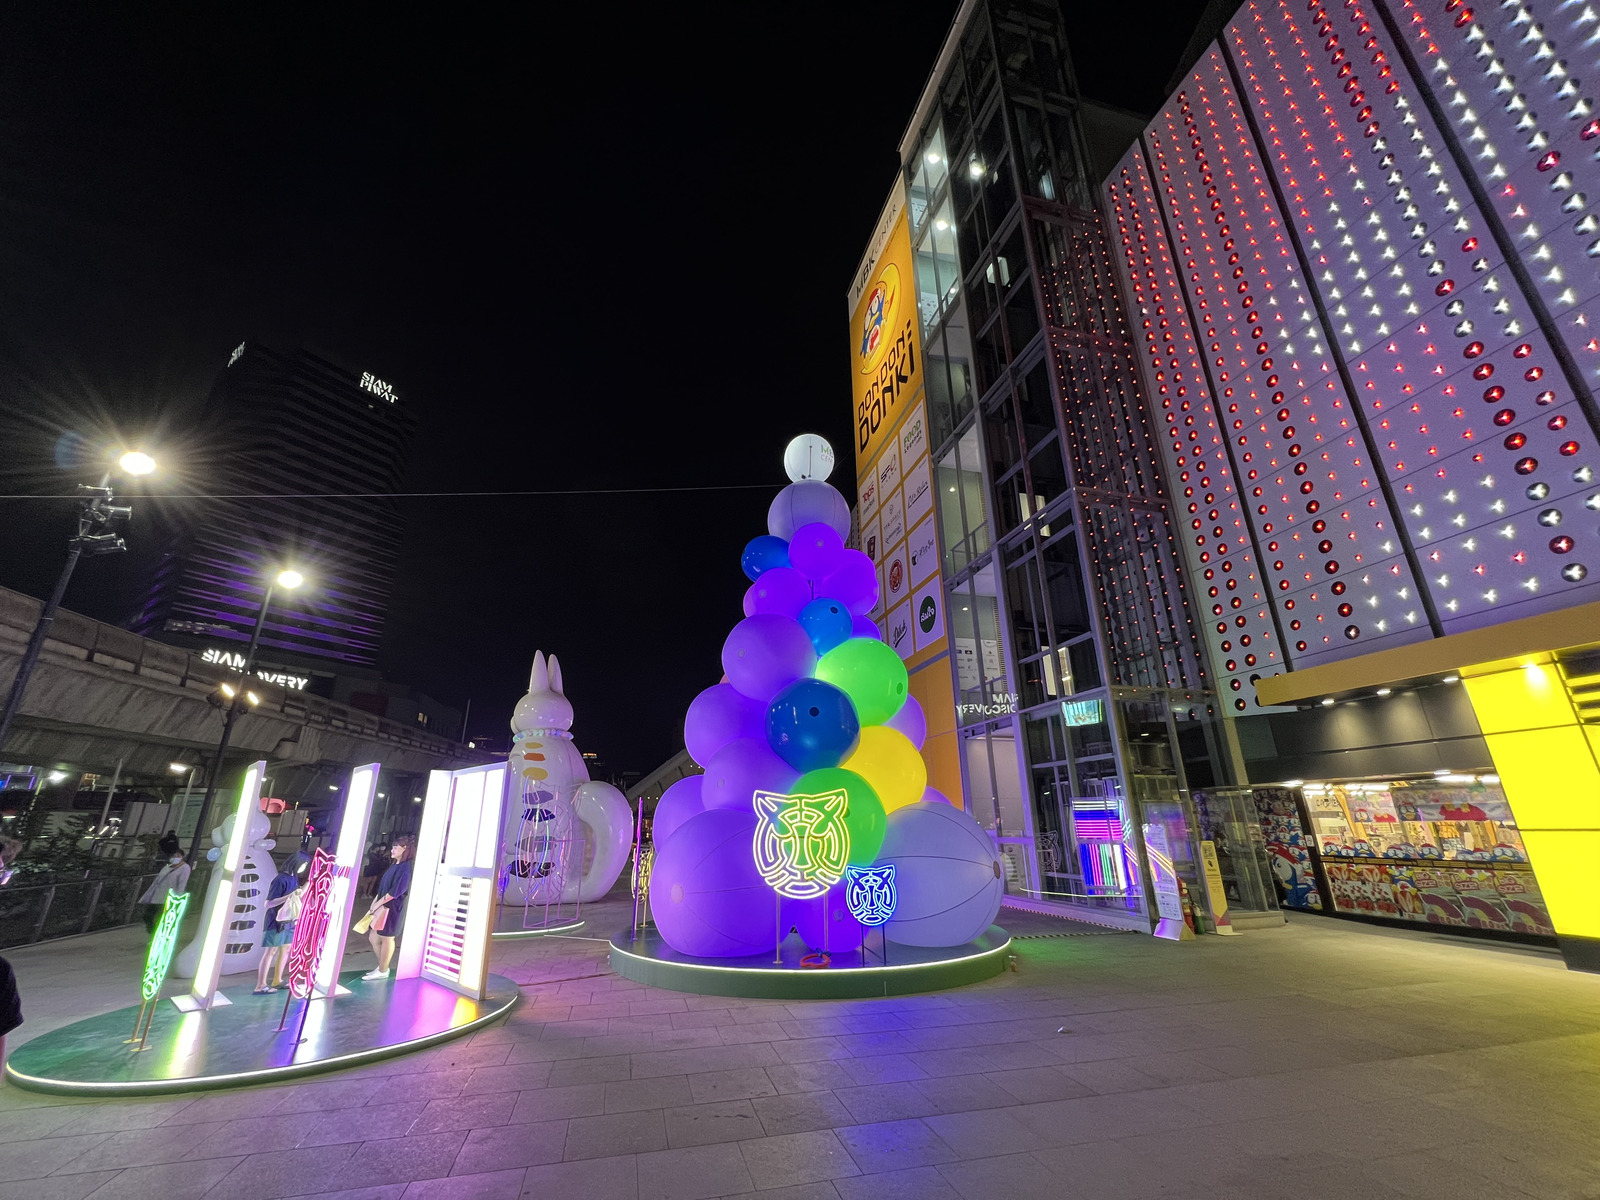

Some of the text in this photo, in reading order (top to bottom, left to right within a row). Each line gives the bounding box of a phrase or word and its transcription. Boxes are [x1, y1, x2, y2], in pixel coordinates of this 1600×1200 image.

[856, 248, 875, 299] MBK
[875, 204, 897, 254] CENTER
[361, 371, 393, 394] SIAM
[858, 330, 905, 424] DON DON
[359, 378, 399, 404] PIWAT
[904, 419, 921, 447] FOOD
[201, 648, 246, 668] SIAM
[1415, 880, 1436, 888] SIZE
[1455, 881, 1478, 890] SIZE
